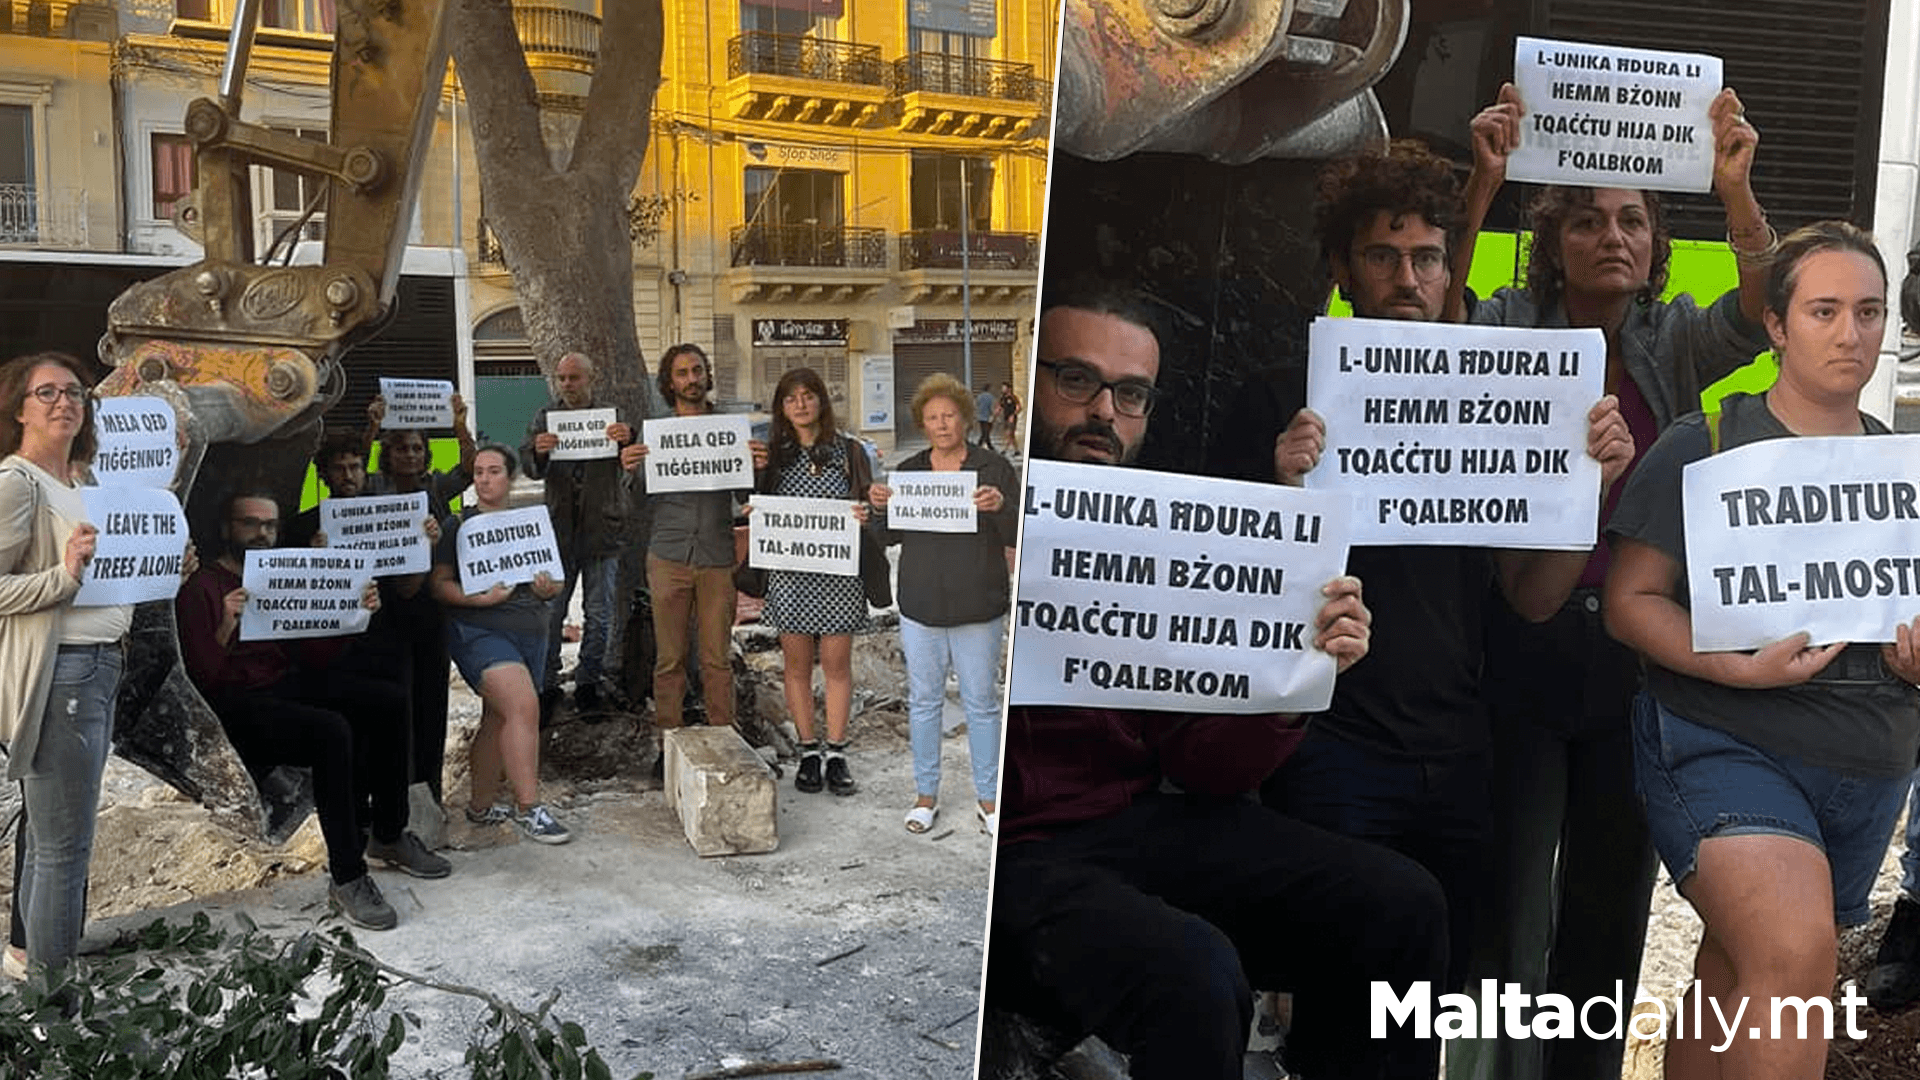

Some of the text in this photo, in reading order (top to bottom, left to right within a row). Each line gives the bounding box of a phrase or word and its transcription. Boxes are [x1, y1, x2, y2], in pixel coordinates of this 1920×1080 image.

[1538, 50, 1700, 78] L-UNIKA ĦDURA LI
[1552, 82, 1681, 108] HEMM BŻONN
[1533, 113, 1694, 143] TQAĊĊTU HIJA DIK
[1558, 150, 1663, 174] F'QALBKOM
[1340, 346, 1579, 376] L-UNIKA ĦDURA LI
[1364, 392, 1550, 424] HEMM BŻONN
[102, 413, 167, 433] MELA QED
[558, 420, 606, 432] MELA QED
[660, 432, 737, 449] MELA QED
[99, 446, 172, 472] TIĠĠENNU?
[656, 457, 743, 477] TIĠĠENNU?
[1338, 442, 1570, 476] TQAĊĊTU HIJA DIK
[900, 484, 964, 498] TRADITURI
[894, 506, 969, 520] TAL-MOSTIN
[1025, 485, 1322, 544] L-UNIKA ĦDURA LI
[1379, 499, 1529, 526] F'QALBKOM
[1721, 482, 1920, 527] TRADITUR
[106, 513, 176, 536] LEAVE THE
[762, 512, 846, 531] TRADITURI
[466, 522, 542, 548] TRADITURI
[466, 548, 553, 576] TAL-MOSTIN
[758, 539, 851, 560] TAL-MOSTIN
[94, 555, 181, 580] TREES ALONE
[258, 557, 307, 569] L-UNIKA
[354, 559, 364, 570] LI
[1052, 548, 1284, 596] HEMM BŻONN
[268, 578, 306, 590] HEMM
[310, 598, 336, 610] HIJA
[1018, 600, 1306, 650] TQAĊĊTU HIJA DIK
[1064, 658, 1250, 699] F'QALBKOM
